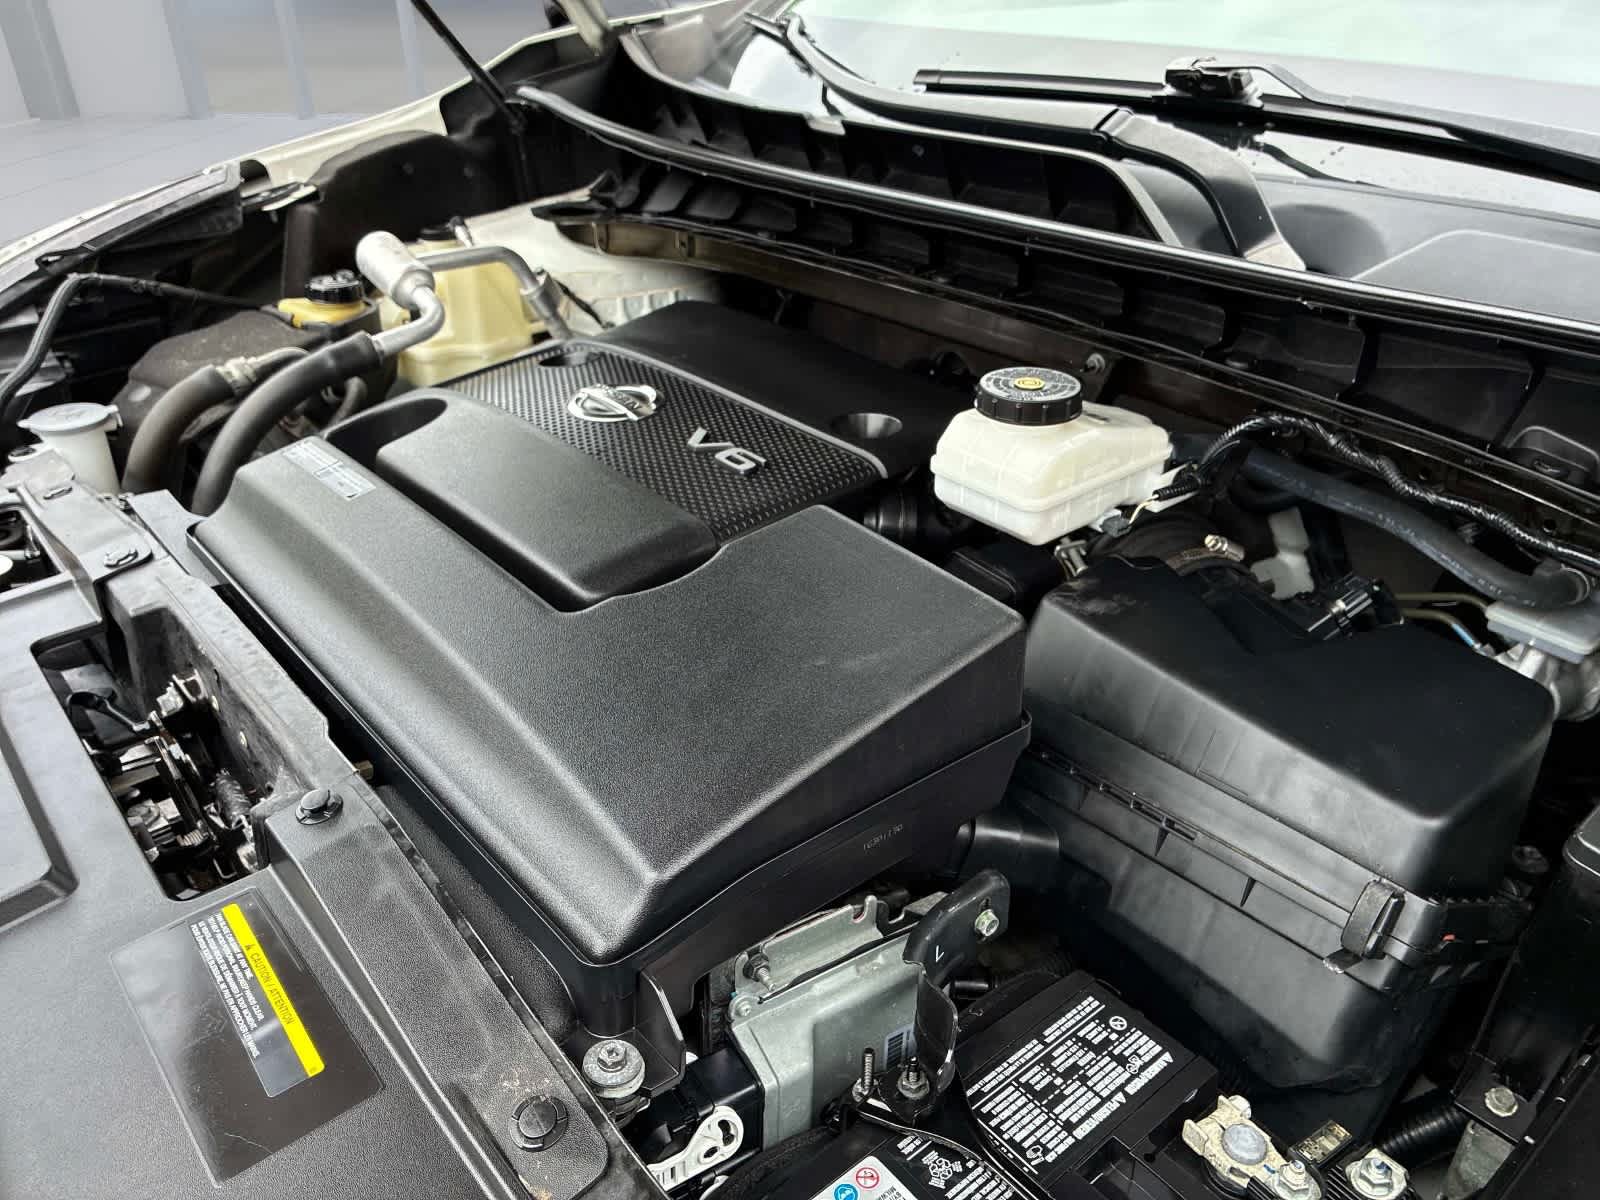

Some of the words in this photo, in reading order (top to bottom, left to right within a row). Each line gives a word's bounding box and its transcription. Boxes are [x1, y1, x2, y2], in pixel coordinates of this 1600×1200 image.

[687, 426, 766, 474] V6
[249, 951, 272, 983] CAUTION
[268, 986, 296, 1025] ATTENTION
